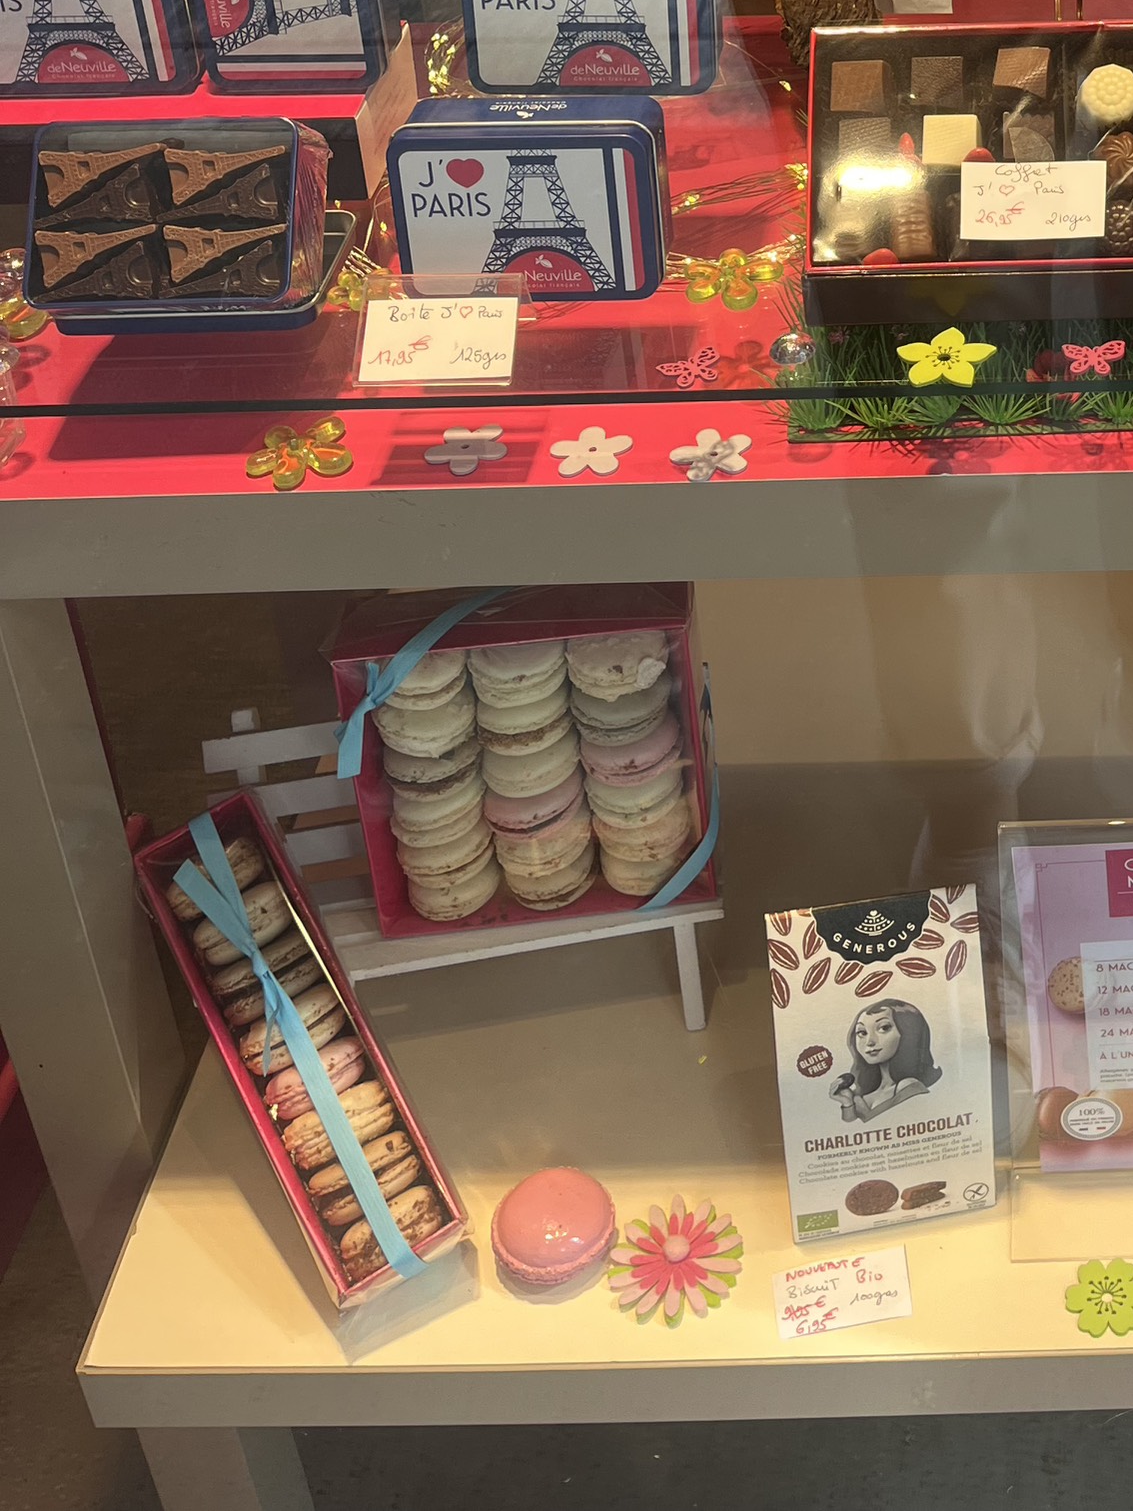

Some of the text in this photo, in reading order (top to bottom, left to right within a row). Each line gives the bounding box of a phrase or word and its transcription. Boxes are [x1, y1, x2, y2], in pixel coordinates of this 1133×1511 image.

[570, 65, 640, 76] deNeuville
[411, 192, 491, 218] PARIS
[524, 270, 582, 282] Neuville
[832, 922, 916, 954] GENEROUS
[1096, 963, 1104, 973] 8
[1097, 985, 1108, 995] 12
[1099, 1007, 1110, 1017] 18
[1100, 1028, 1114, 1038] 24
[799, 1051, 829, 1070] GLUTEN
[808, 1061, 828, 1076] FREE
[1079, 1107, 1106, 1117] 100%
[804, 1112, 973, 1153] CHARLOTTE CHOCOLAT
[817, 1150, 857, 1160] FORMERLY
[858, 1145, 890, 1154] KNOWN
[901, 1139, 920, 1147] MISS
[921, 1131, 962, 1143] GENEROUS
[856, 1269, 883, 1284] Bio
